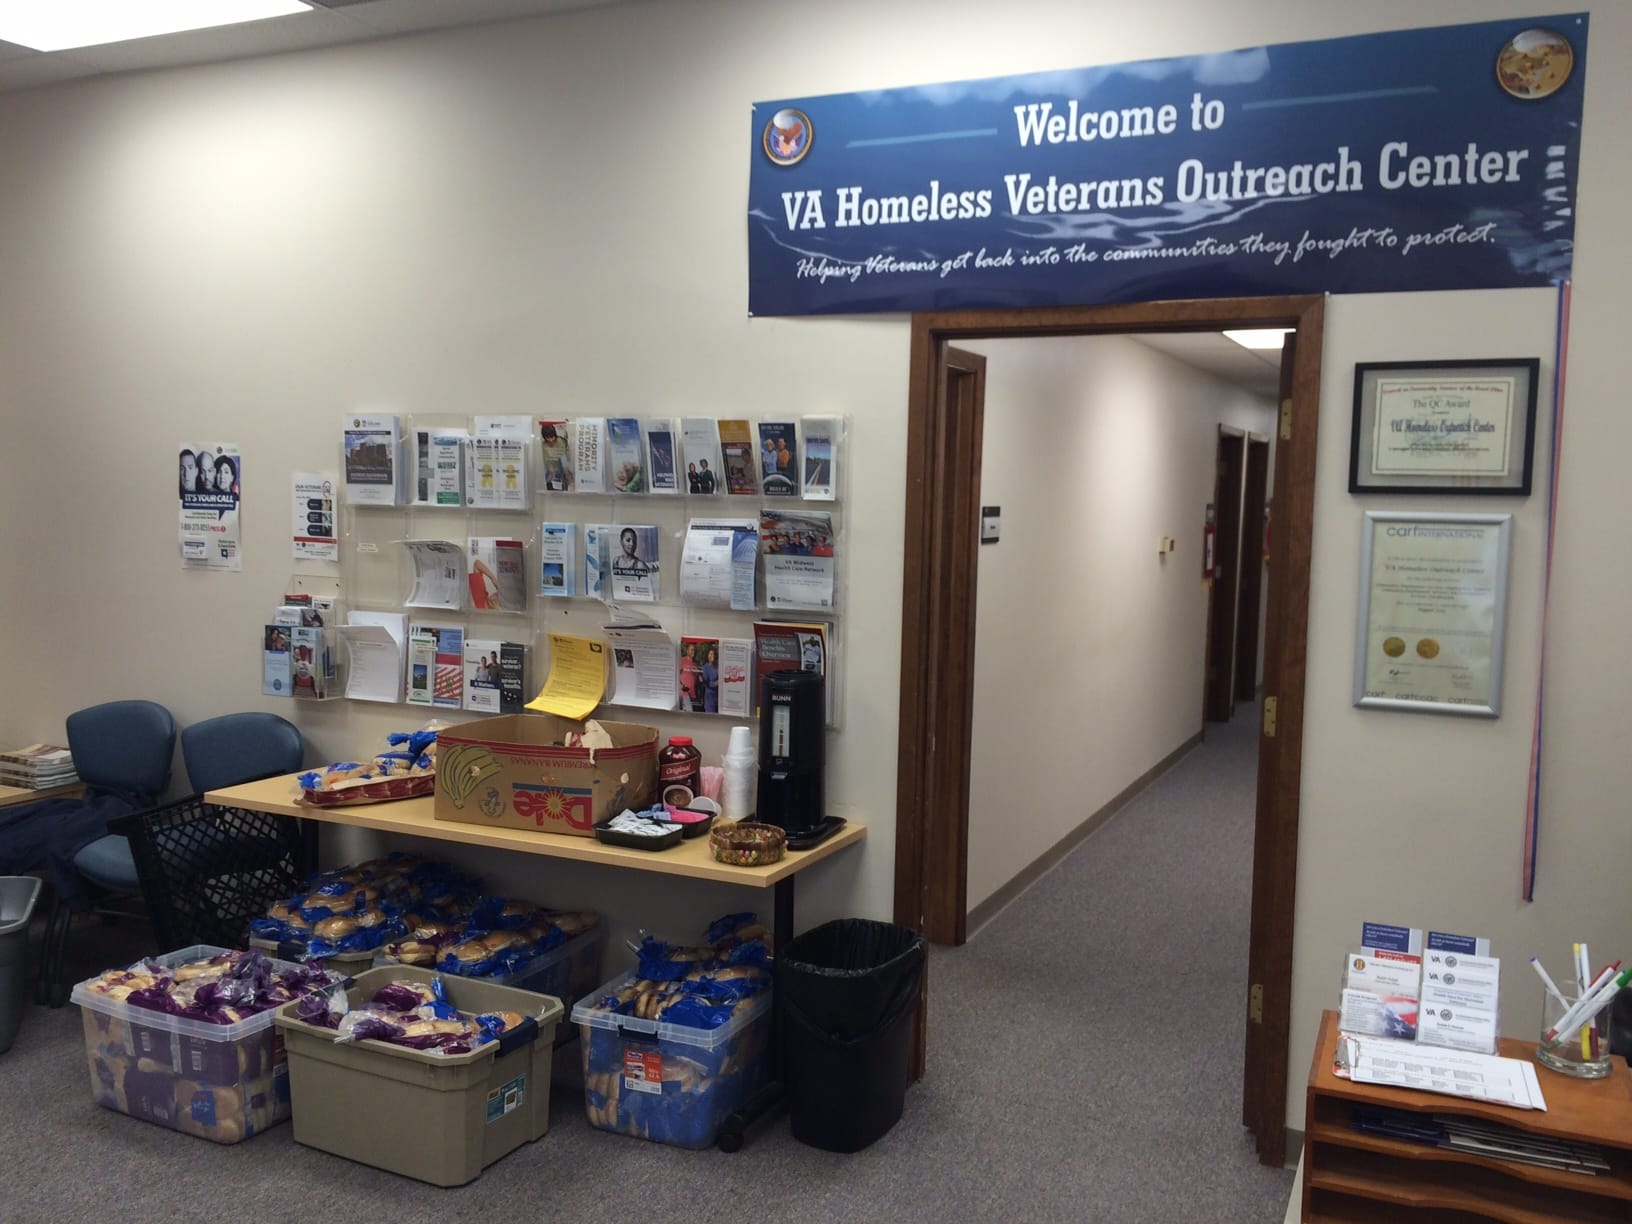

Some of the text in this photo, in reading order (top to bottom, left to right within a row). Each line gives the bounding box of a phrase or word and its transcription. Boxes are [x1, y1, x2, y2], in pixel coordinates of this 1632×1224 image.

[1014, 93, 1225, 147] Welcome to
[781, 142, 1529, 231] VA Homeless Veterans Outreach Center
[796, 221, 1497, 284] Helping Veterans get back into the communities they fought to protect.
[184, 493, 234, 503] IT'S YOUR CALL
[1386, 525, 1419, 537] carf
[771, 694, 792, 702] BUNN
[512, 790, 593, 831] Dole
[1431, 955, 1441, 963] VA
[1425, 1008, 1436, 1017] VA
